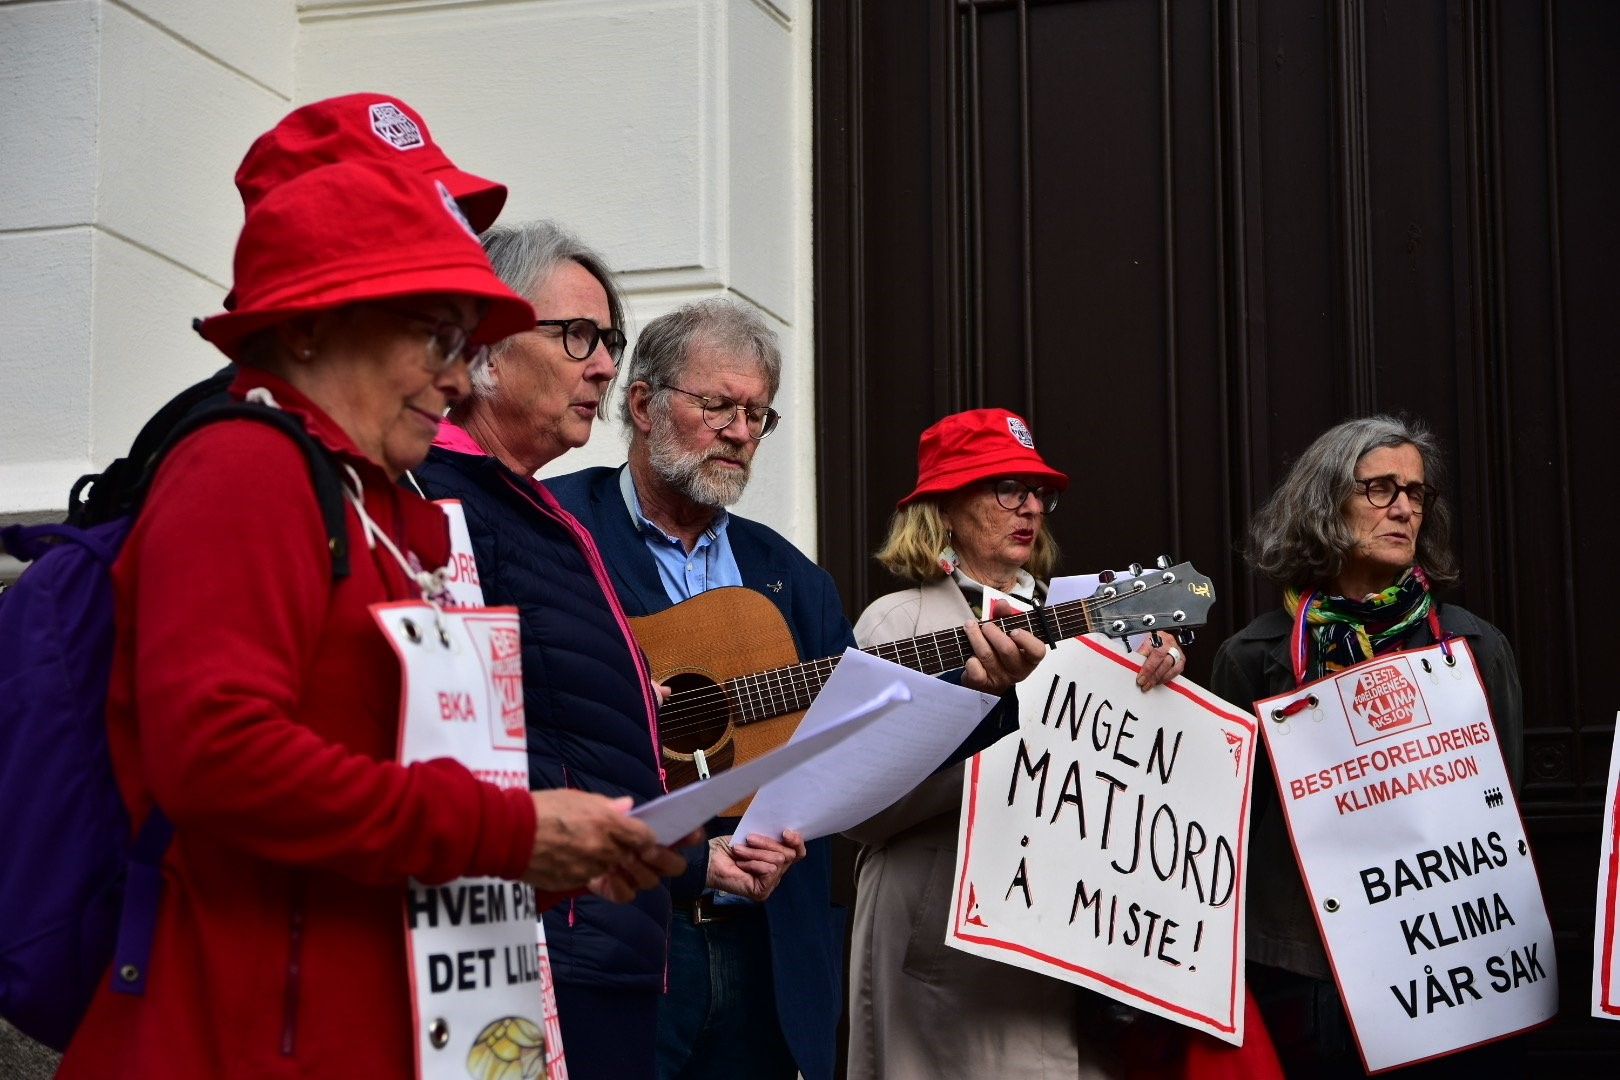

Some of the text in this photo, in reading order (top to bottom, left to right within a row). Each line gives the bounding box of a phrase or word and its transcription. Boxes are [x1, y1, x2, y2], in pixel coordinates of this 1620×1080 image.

[437, 692, 477, 721] BKA
[1354, 675, 1409, 705] FORELDRENES
[1357, 687, 1417, 718] KLIMA
[1360, 668, 1396, 691] BESTE
[1041, 674, 1183, 785] INGEN
[1372, 702, 1416, 730] AKSJON
[1290, 721, 1491, 800] BESTEFORELDRENES
[1334, 755, 1479, 815] KLIMAAKSJON
[1007, 738, 1236, 907] MATJORD
[1359, 831, 1509, 905] BARNAS
[407, 883, 508, 929] HVEM
[1005, 835, 1204, 972] Å MISTE!
[1400, 892, 1516, 955] KLIMA
[428, 949, 495, 994] DET
[1390, 942, 1547, 1020] VÅR SAK
